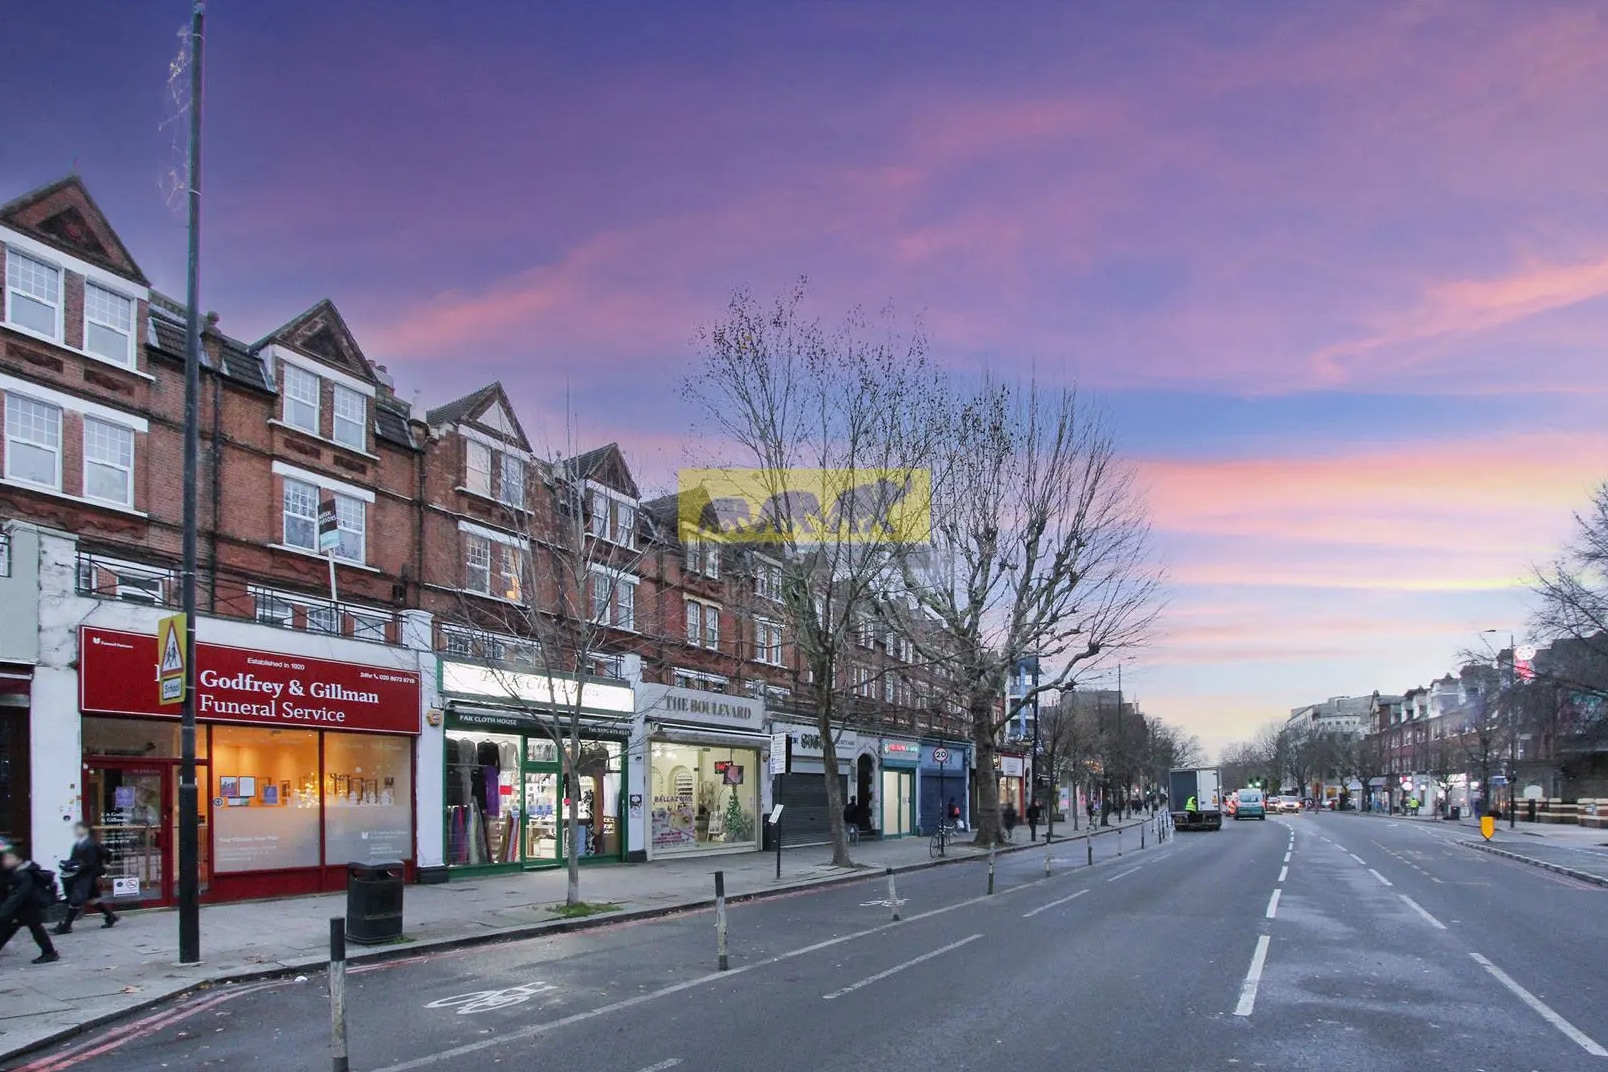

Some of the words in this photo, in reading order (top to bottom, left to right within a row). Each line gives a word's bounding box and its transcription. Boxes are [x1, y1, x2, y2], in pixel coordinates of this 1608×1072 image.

[247, 658, 282, 668] Established
[291, 663, 305, 671] 1920
[200, 669, 284, 698] Godfrey
[288, 679, 306, 697] &
[309, 682, 379, 704] Gillman
[199, 693, 277, 717] Funeral
[282, 701, 346, 722] Service
[666, 695, 689, 712] THE
[690, 699, 752, 719] BOULEVARD
[459, 714, 473, 722] PAK
[474, 716, 496, 724] CLOTH
[496, 718, 518, 726] HOUSE
